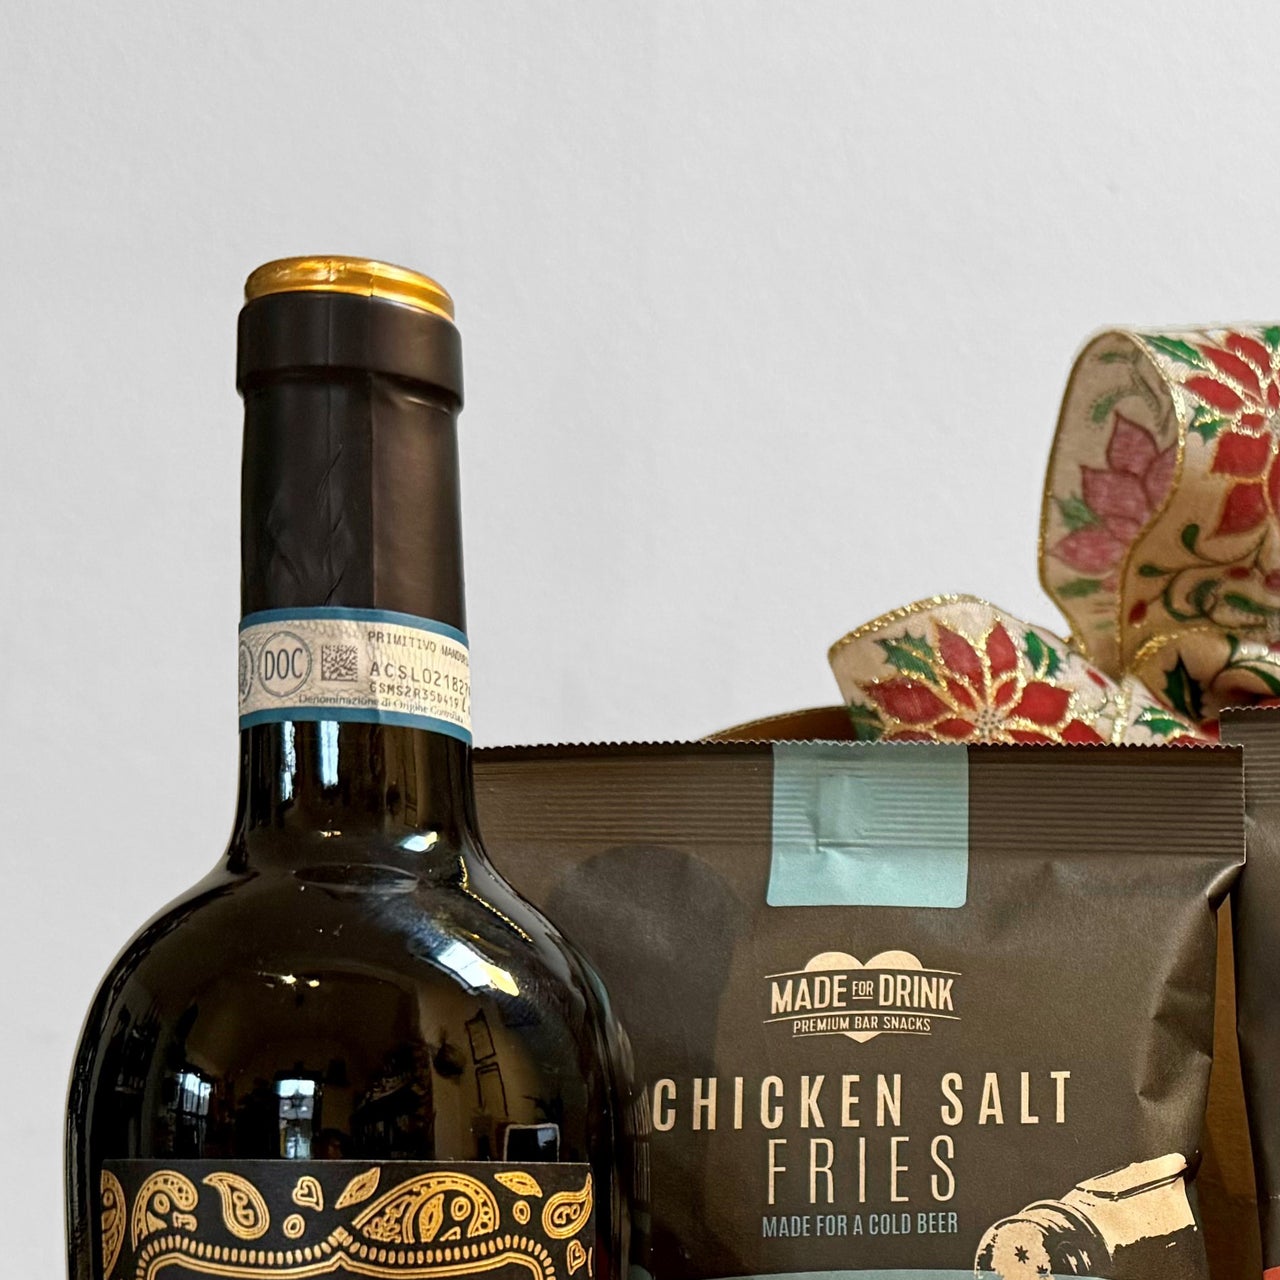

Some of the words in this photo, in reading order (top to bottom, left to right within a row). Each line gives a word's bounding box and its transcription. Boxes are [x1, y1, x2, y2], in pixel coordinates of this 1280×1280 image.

[367, 630, 437, 653] PRIMITIVO
[265, 647, 303, 681] DOC
[771, 974, 848, 1015] MADE
[852, 980, 874, 996] FOR
[879, 973, 954, 1012] DRINK
[793, 1016, 850, 1034] PREMIUM
[854, 1016, 879, 1030] BAR
[883, 1016, 931, 1032] SNACKS
[652, 1073, 902, 1132] CHICKEN
[941, 1070, 1072, 1126] SALT
[767, 1134, 957, 1206] FRIES
[762, 1215, 811, 1238] MADE
[816, 1214, 848, 1237] FOR
[852, 1214, 864, 1236] A
[868, 1213, 912, 1235] COLD
[917, 1211, 958, 1234] BEER
